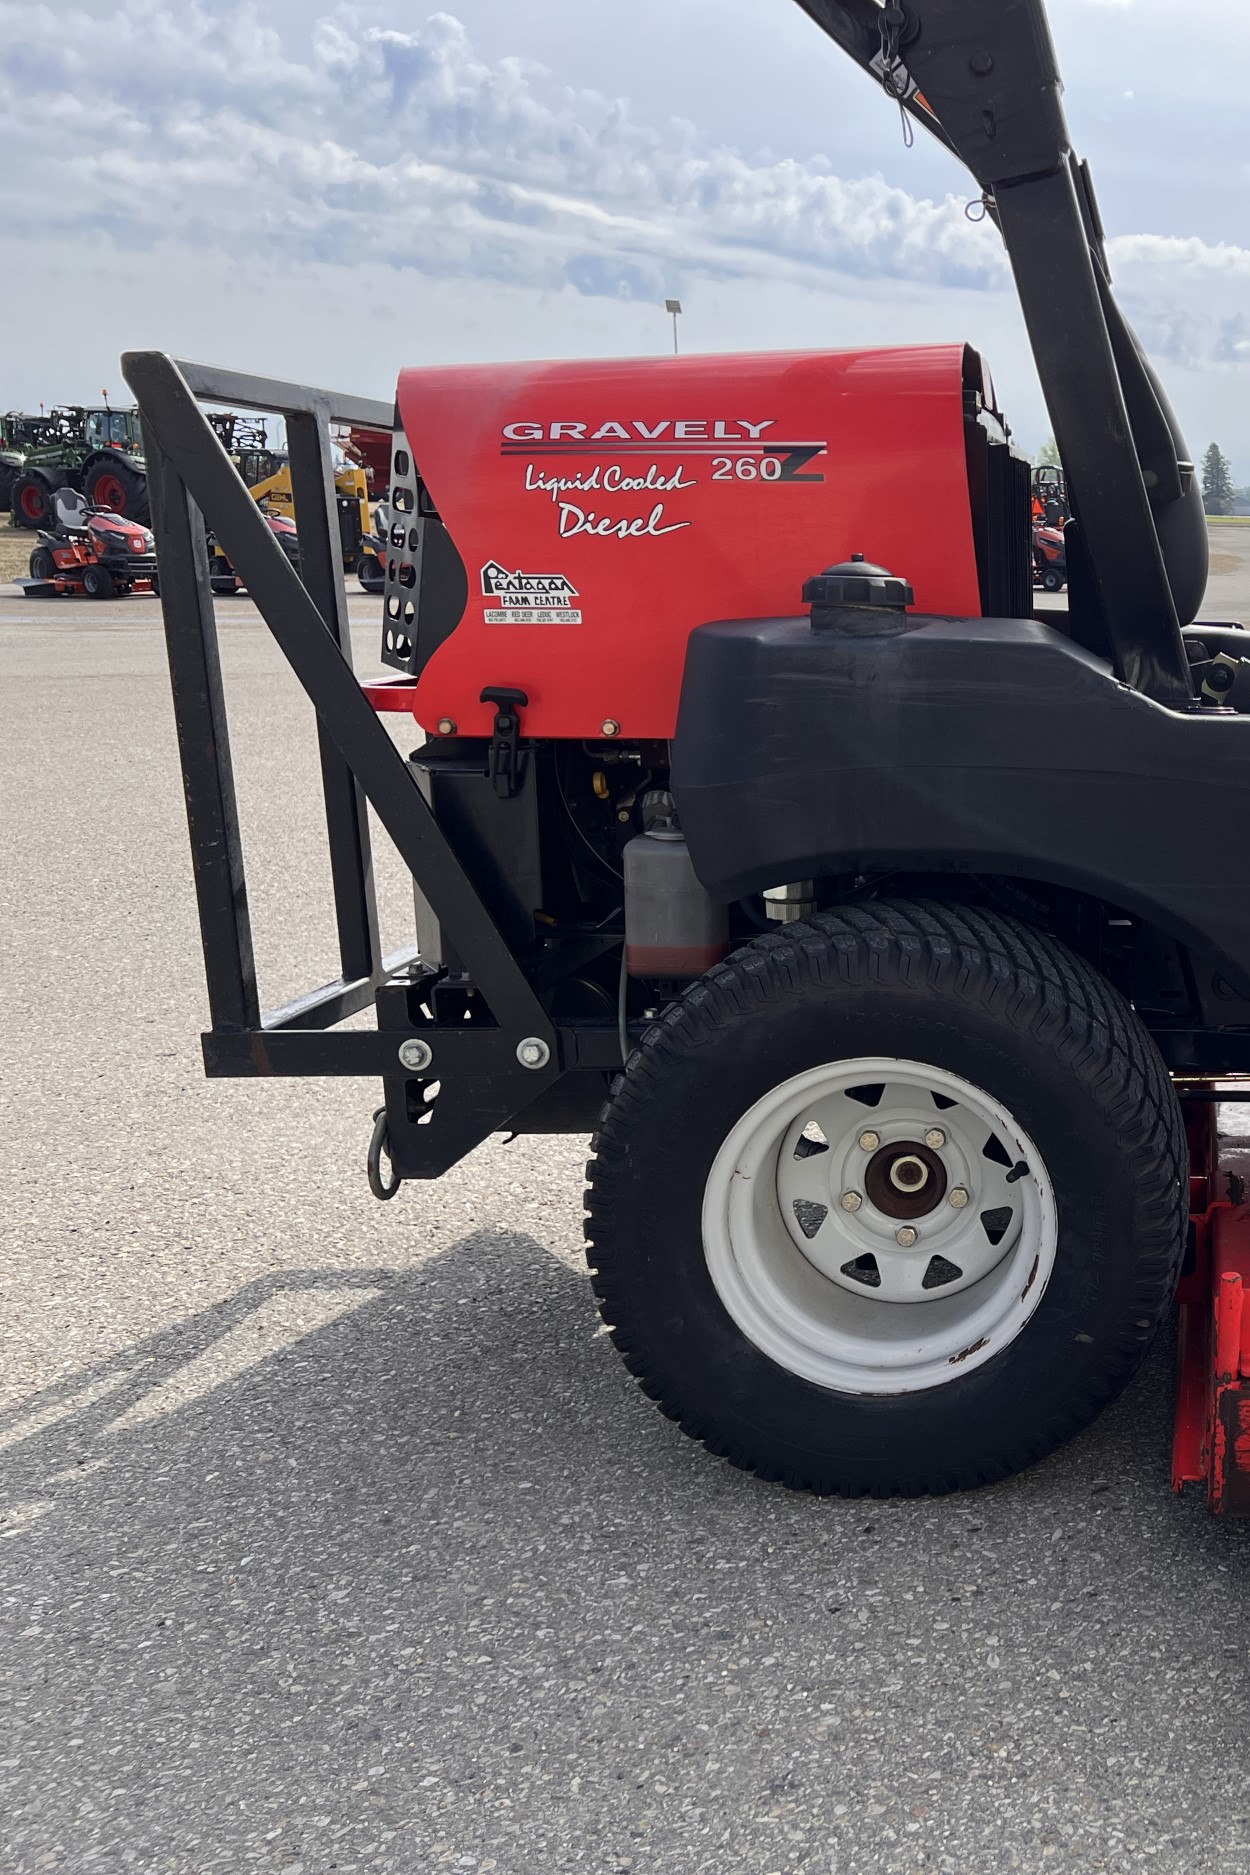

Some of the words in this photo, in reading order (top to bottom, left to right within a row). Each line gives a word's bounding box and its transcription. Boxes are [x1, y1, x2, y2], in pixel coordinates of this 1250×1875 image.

[502, 420, 777, 440] GRAVELY
[525, 463, 600, 502] Liquid
[603, 464, 698, 492] Cooled
[558, 503, 692, 539] Diesel
[503, 596, 531, 606] FARM
[534, 596, 569, 606] CENTRE
